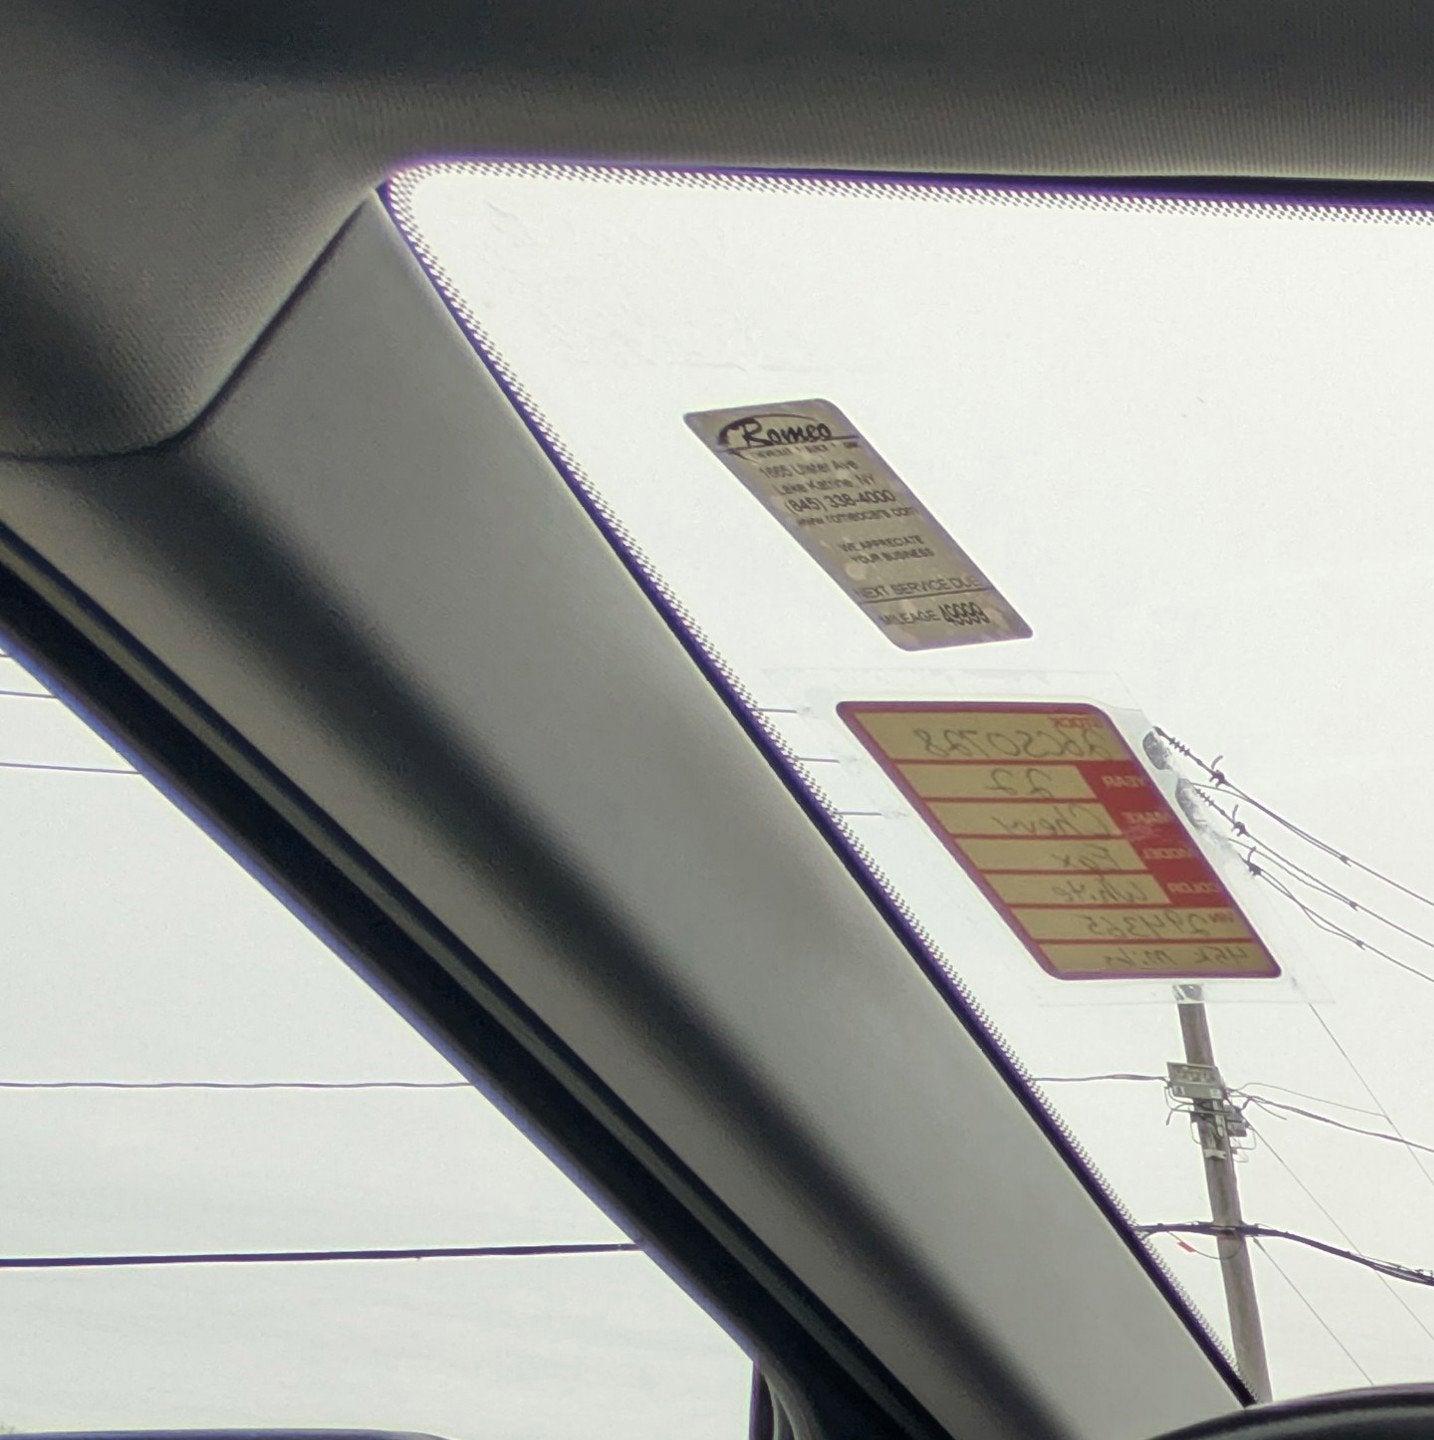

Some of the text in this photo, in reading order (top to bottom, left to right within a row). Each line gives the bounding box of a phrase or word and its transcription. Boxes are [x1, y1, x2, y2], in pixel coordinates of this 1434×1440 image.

[740, 416, 832, 447] Romeo
[785, 489, 897, 513] (845) 338-4000
[891, 579, 950, 595] SERVICE
